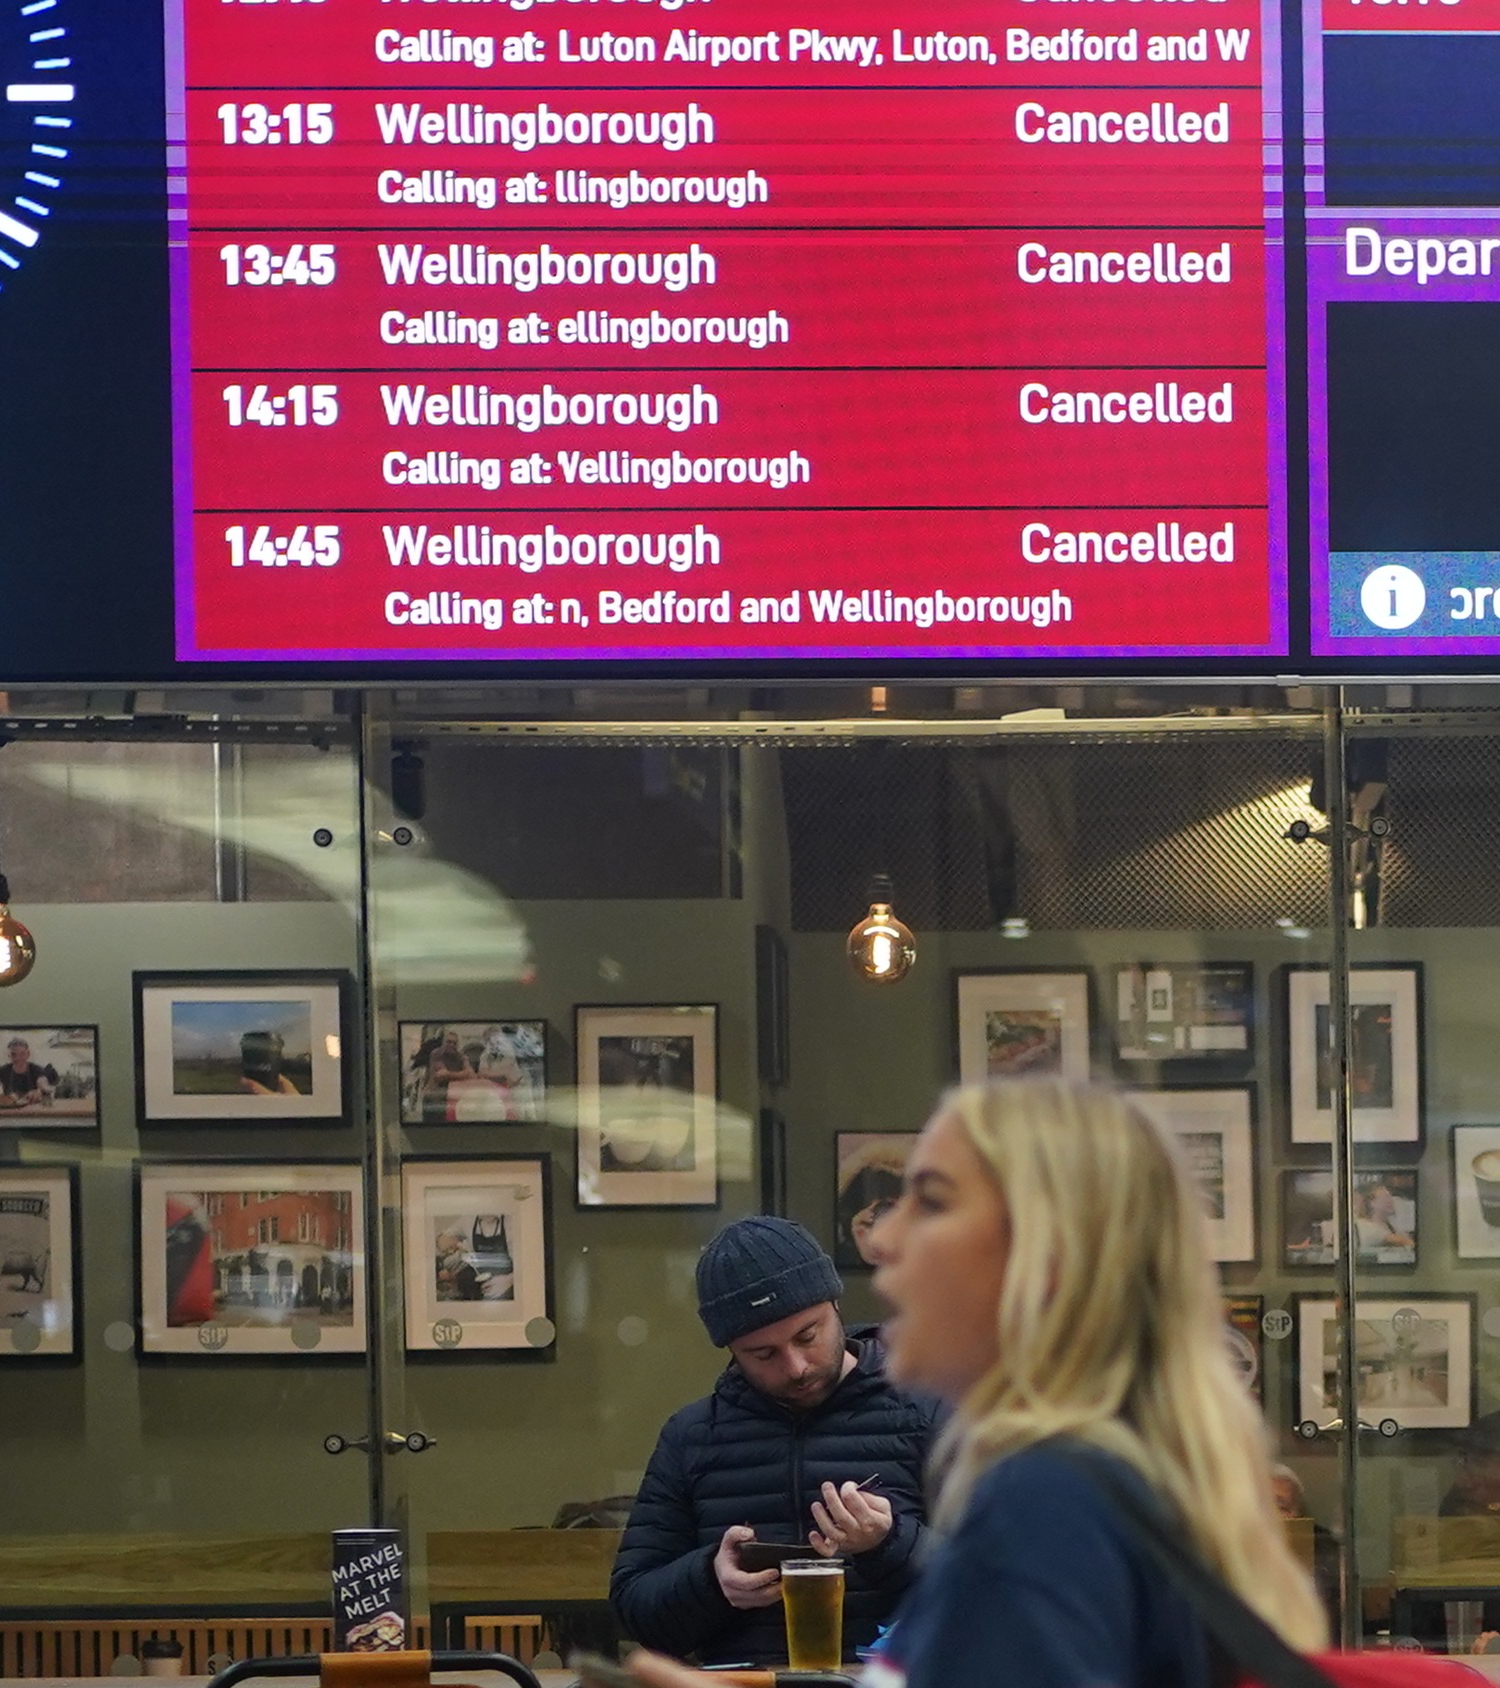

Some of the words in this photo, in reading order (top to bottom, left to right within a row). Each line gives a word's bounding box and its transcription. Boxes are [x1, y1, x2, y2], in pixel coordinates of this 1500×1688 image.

[375, 29, 494, 67] Calling
[502, 31, 545, 62] at:
[559, 29, 655, 62] Luton
[663, 29, 780, 67] Airport
[789, 29, 883, 67] Pkwy,
[893, 29, 997, 65] Luton,
[1006, 28, 1138, 62] Bedford
[1146, 28, 1207, 62] and
[1214, 28, 1250, 61] W
[217, 103, 333, 144] 13:15
[375, 103, 714, 150] Wellingborough
[1015, 102, 1229, 143] Cancelled
[377, 169, 496, 209] Calling
[505, 172, 547, 203] at:
[220, 244, 336, 286] 13:45
[377, 243, 716, 292] Wellingborough
[1017, 242, 1231, 283] Cancelled
[380, 310, 498, 350] Calling
[507, 312, 550, 344] at:
[223, 385, 338, 426] 14:15
[380, 384, 718, 433] Wellingborough
[1020, 382, 1232, 423] Cancelled
[382, 451, 501, 490] Calling
[510, 452, 552, 484] at:
[225, 525, 340, 567] 14:45
[382, 524, 720, 573] Wellingborough
[1022, 522, 1234, 563] Cancelled
[385, 591, 503, 630] Calling
[512, 593, 556, 624] at:
[598, 590, 730, 624] Bedford
[740, 590, 800, 623] and
[808, 589, 1072, 628] Wellingborough
[331, 1543, 404, 1583] MARVEL
[340, 1580, 361, 1602] AT
[365, 1563, 402, 1589] THE
[344, 1587, 391, 1620] MELT
